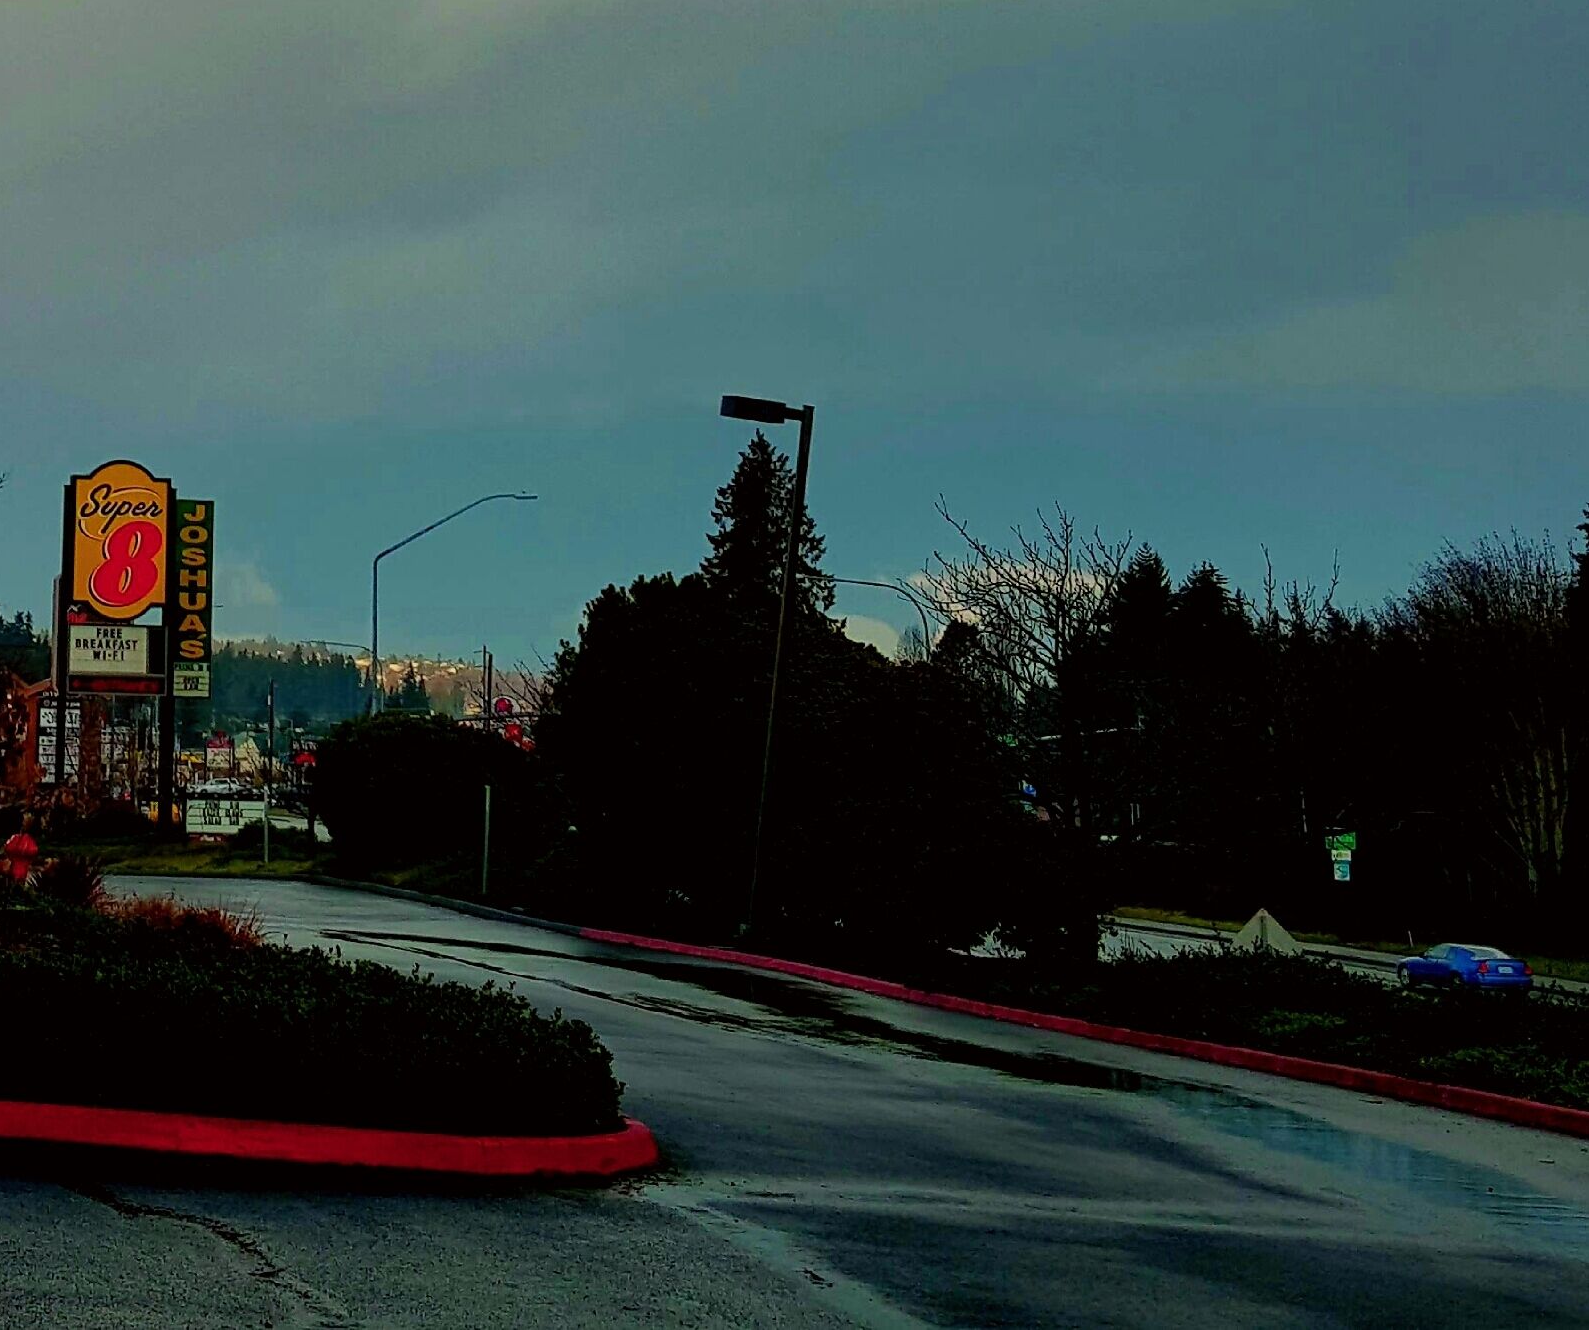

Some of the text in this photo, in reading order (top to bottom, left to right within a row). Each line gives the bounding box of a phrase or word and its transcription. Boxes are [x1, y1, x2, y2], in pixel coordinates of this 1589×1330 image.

[79, 483, 163, 535] Super
[89, 520, 163, 607] 8
[178, 504, 209, 659] JOSHUA'S
[75, 639, 138, 651] BREAKFAST
[96, 627, 123, 639] FREE
